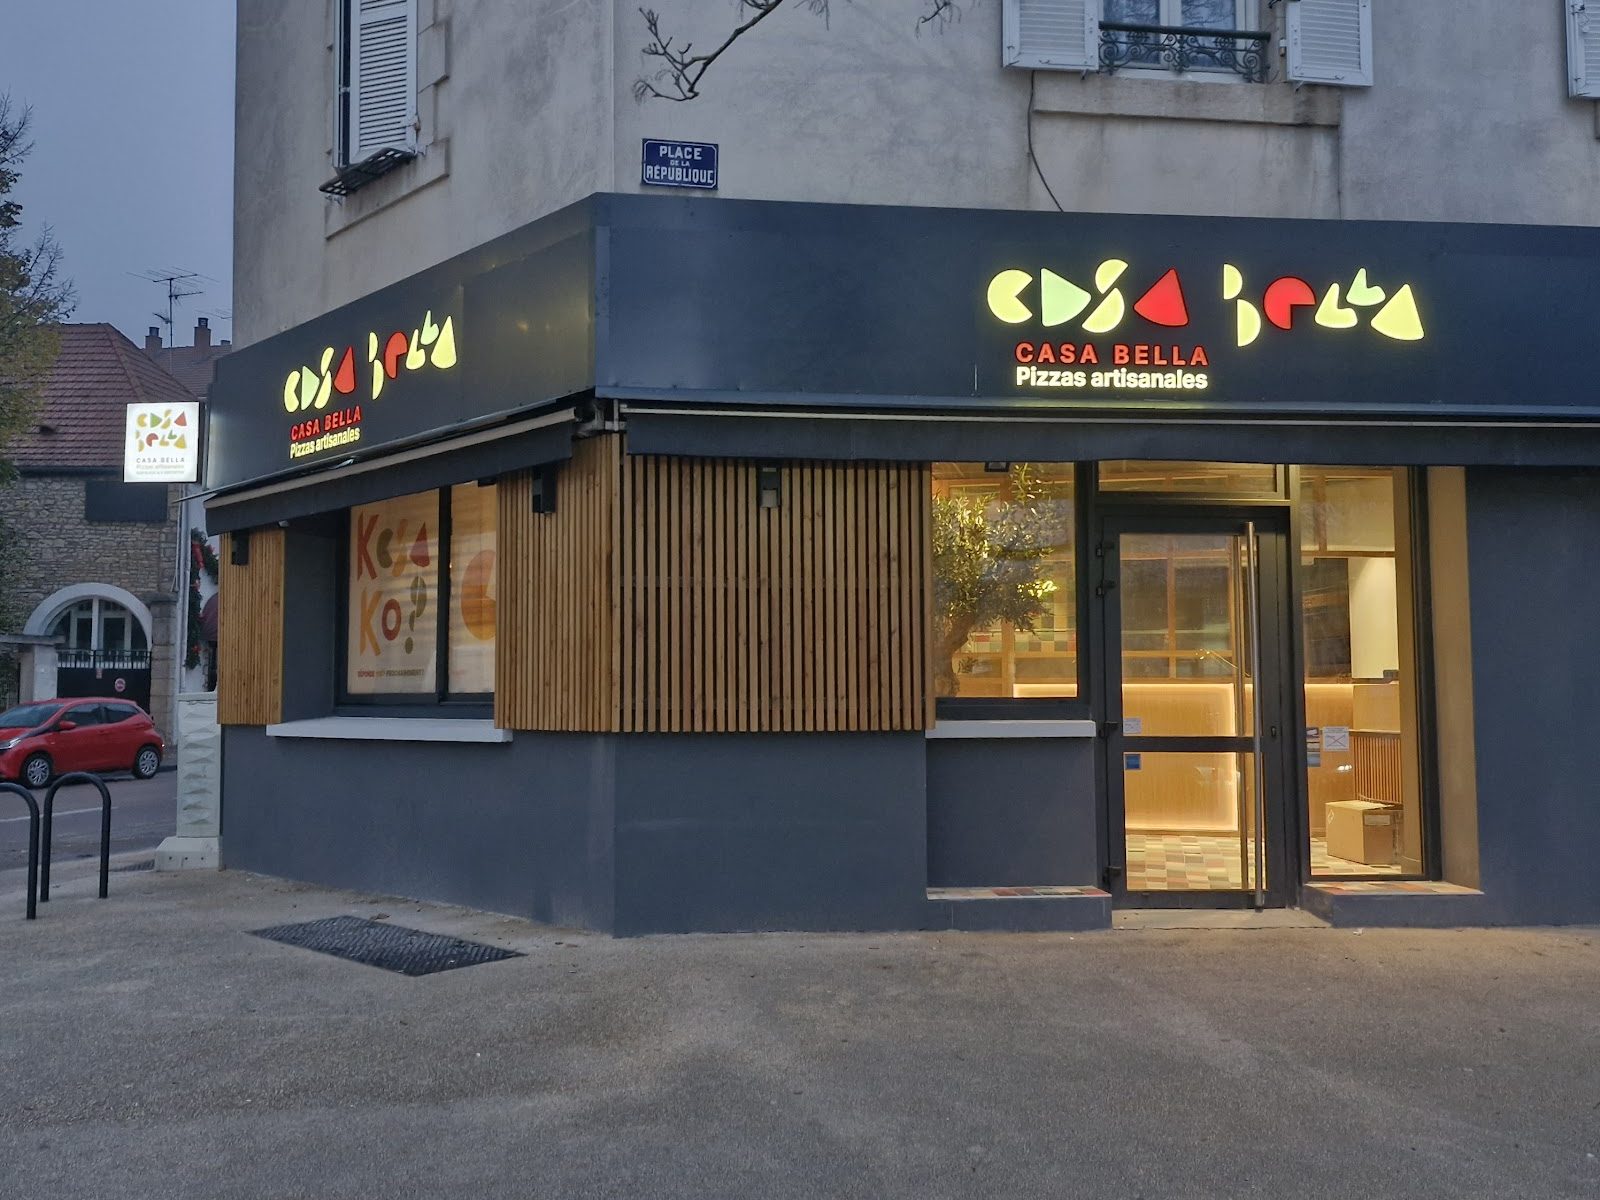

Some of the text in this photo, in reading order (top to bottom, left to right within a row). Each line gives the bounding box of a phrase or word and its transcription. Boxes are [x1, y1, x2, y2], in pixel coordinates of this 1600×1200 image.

[660, 145, 702, 160] PLACE
[646, 165, 714, 184] RÉPUBLIQUE
[986, 258, 1190, 334] CASA
[1015, 341, 1209, 367] CASA BELLA
[283, 346, 356, 413] CASA
[1015, 365, 1209, 390] Pizzas artisanales
[290, 405, 362, 442] CASA BELLA
[289, 426, 361, 460] Pizzas artisanales
[160, 456, 185, 464] BELLA
